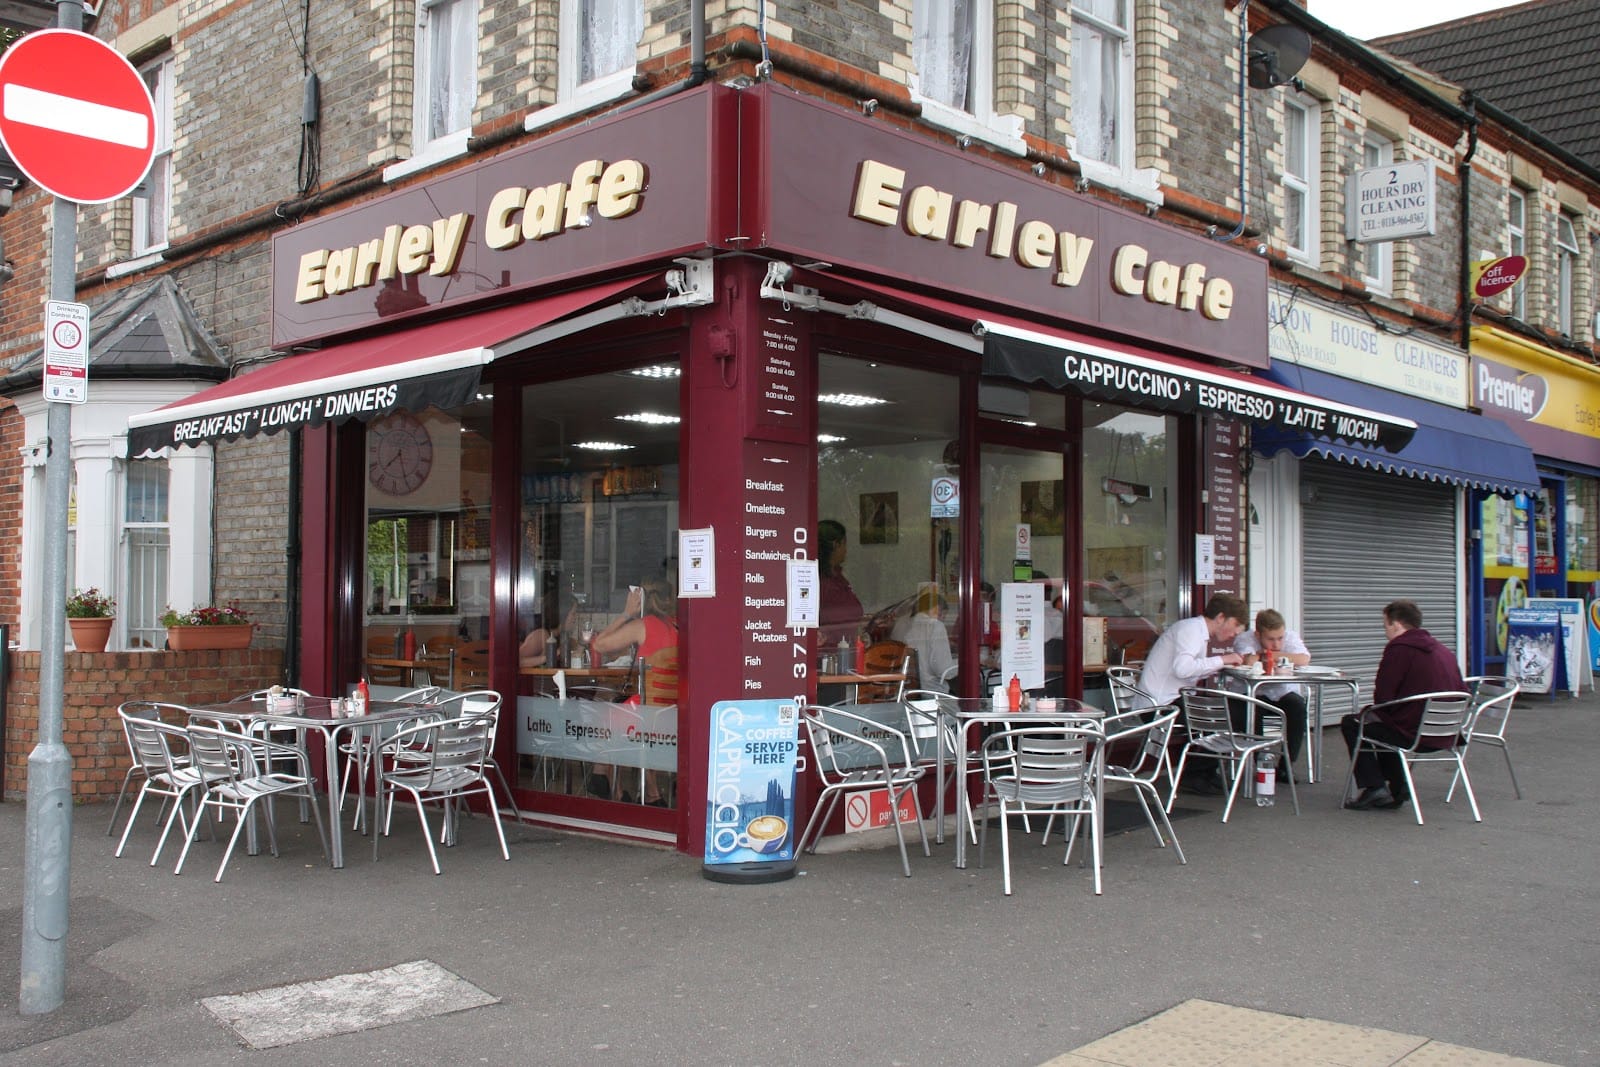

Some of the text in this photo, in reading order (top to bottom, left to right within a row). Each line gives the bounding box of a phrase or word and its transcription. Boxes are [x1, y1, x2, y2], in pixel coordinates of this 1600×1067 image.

[1388, 170, 1397, 184] 2
[1361, 181, 1425, 202] HOURS DRY
[1361, 195, 1425, 216] CLEANING
[295, 159, 645, 303] Earley Cafe
[853, 159, 1233, 320] Earley Cafe
[1487, 265, 1503, 277] off
[1481, 273, 1516, 287] licence
[763, 330, 782, 341] Monday
[1331, 320, 1378, 355] HOUSE
[1394, 341, 1458, 378] CLEANERS
[1479, 363, 1535, 414] Premier
[1064, 355, 1379, 442] CAPPUCCINO ESPRESSO LATTE MOCHA
[174, 384, 398, 442] BREAKFAST LUNCH DINNERS
[745, 479, 784, 492] Breakfast
[745, 503, 786, 515] Omelettes
[745, 526, 778, 539] Burgers
[745, 549, 791, 561] Sandwiches
[745, 573, 765, 584] Rolls
[745, 596, 785, 609] Baguettes
[745, 620, 772, 630] Jacket
[752, 633, 788, 643] Potatoes
[745, 656, 761, 666] Fish
[745, 679, 762, 690] Pies
[527, 716, 552, 733] Latte
[565, 719, 612, 741] Espresso
[745, 728, 793, 740] COFFEE
[745, 741, 794, 754] SERVED
[753, 752, 785, 765] HERE
[879, 808, 909, 823] parng
